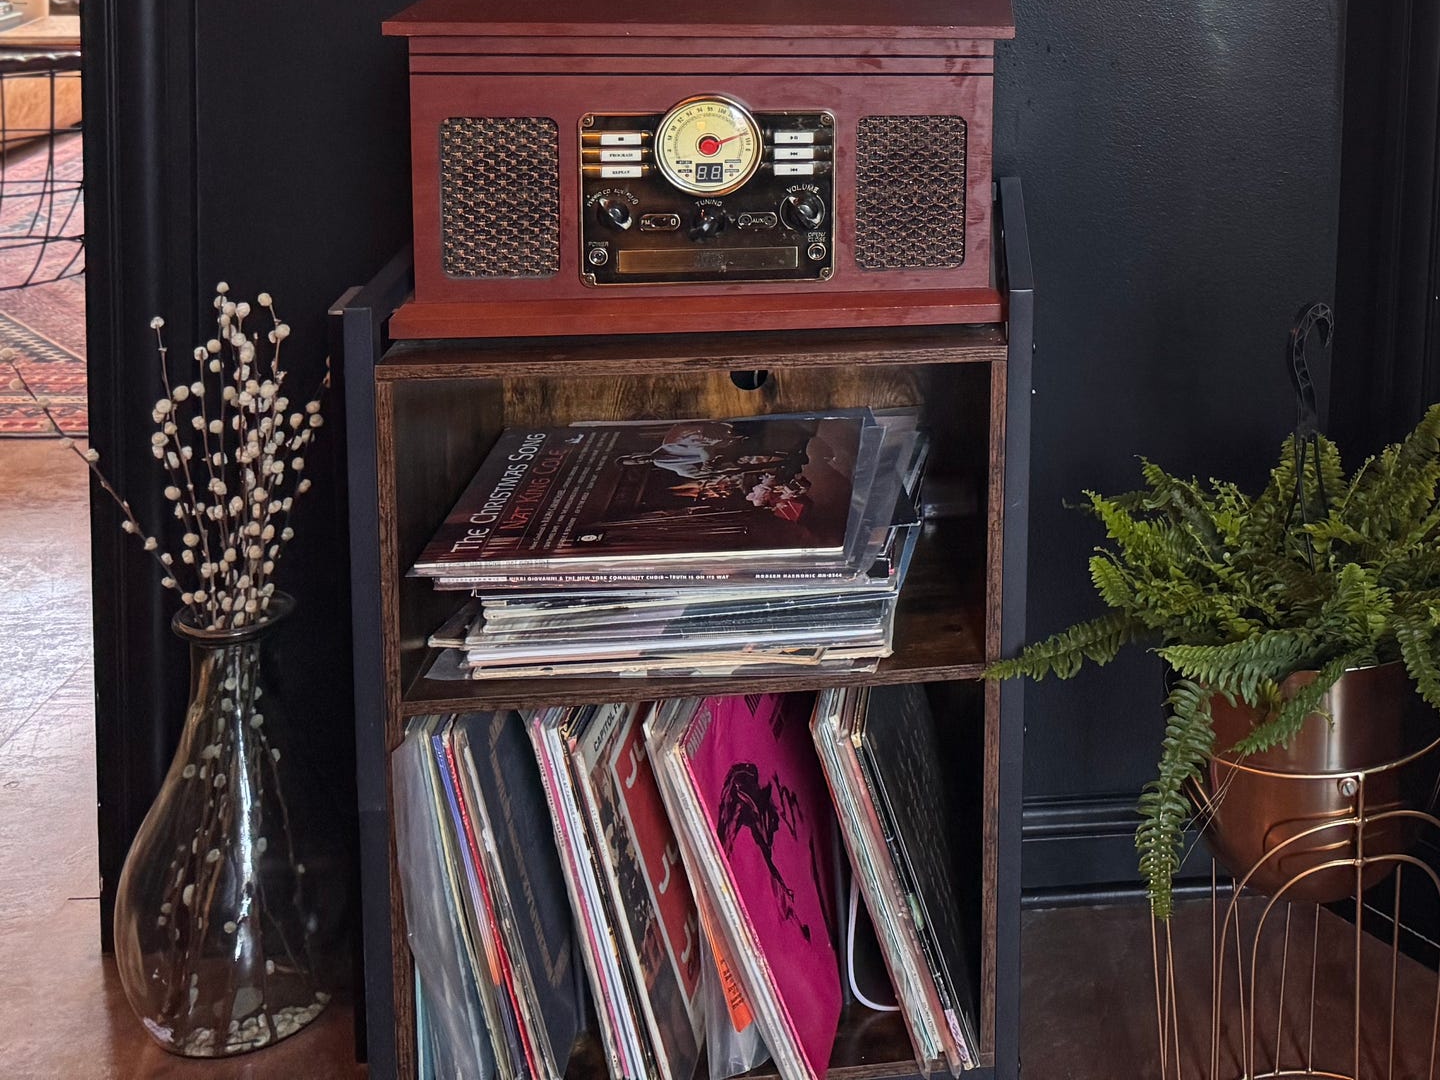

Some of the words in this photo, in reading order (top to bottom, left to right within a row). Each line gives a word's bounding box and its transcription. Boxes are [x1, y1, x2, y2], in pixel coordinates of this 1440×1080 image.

[786, 184, 820, 194] VOLUME
[508, 433, 547, 461] SONG
[532, 449, 568, 474] COLE
[519, 478, 551, 503] KING
[500, 503, 534, 530] NAT
[594, 712, 615, 752] CAPITOL
[686, 705, 712, 760] PHILIPS
